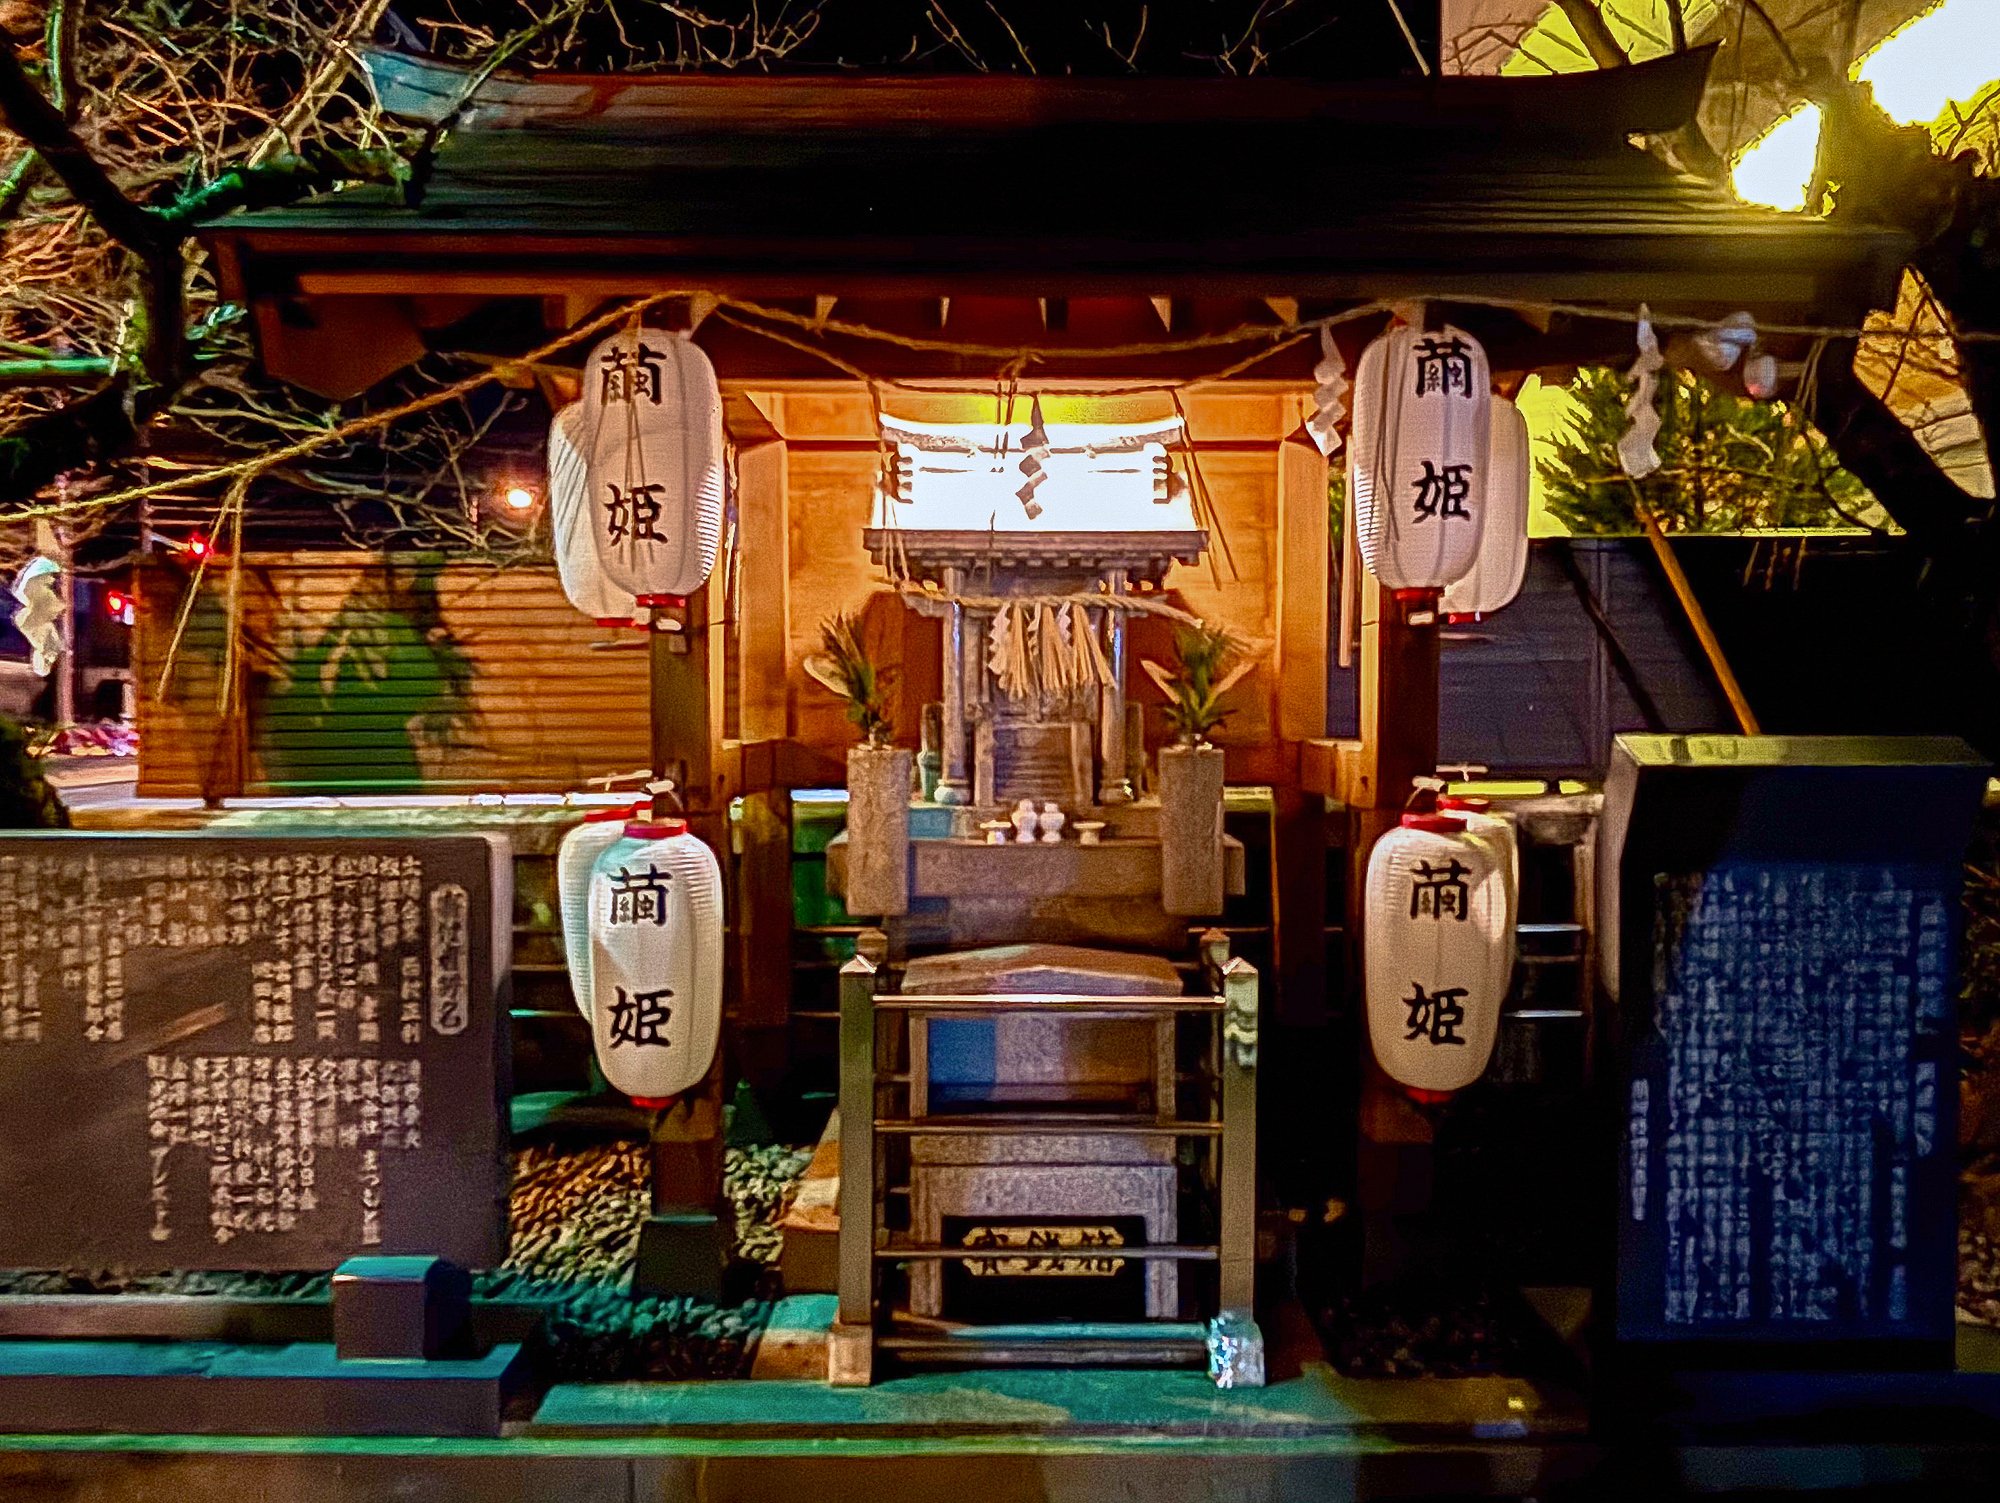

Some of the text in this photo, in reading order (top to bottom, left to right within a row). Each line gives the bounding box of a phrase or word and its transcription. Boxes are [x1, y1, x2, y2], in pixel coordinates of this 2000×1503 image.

[601, 342, 668, 546] 繭姫
[1411, 336, 1474, 524] 繭姫
[607, 863, 675, 1050] 繭姫
[1402, 858, 1472, 1046] 繭姫
